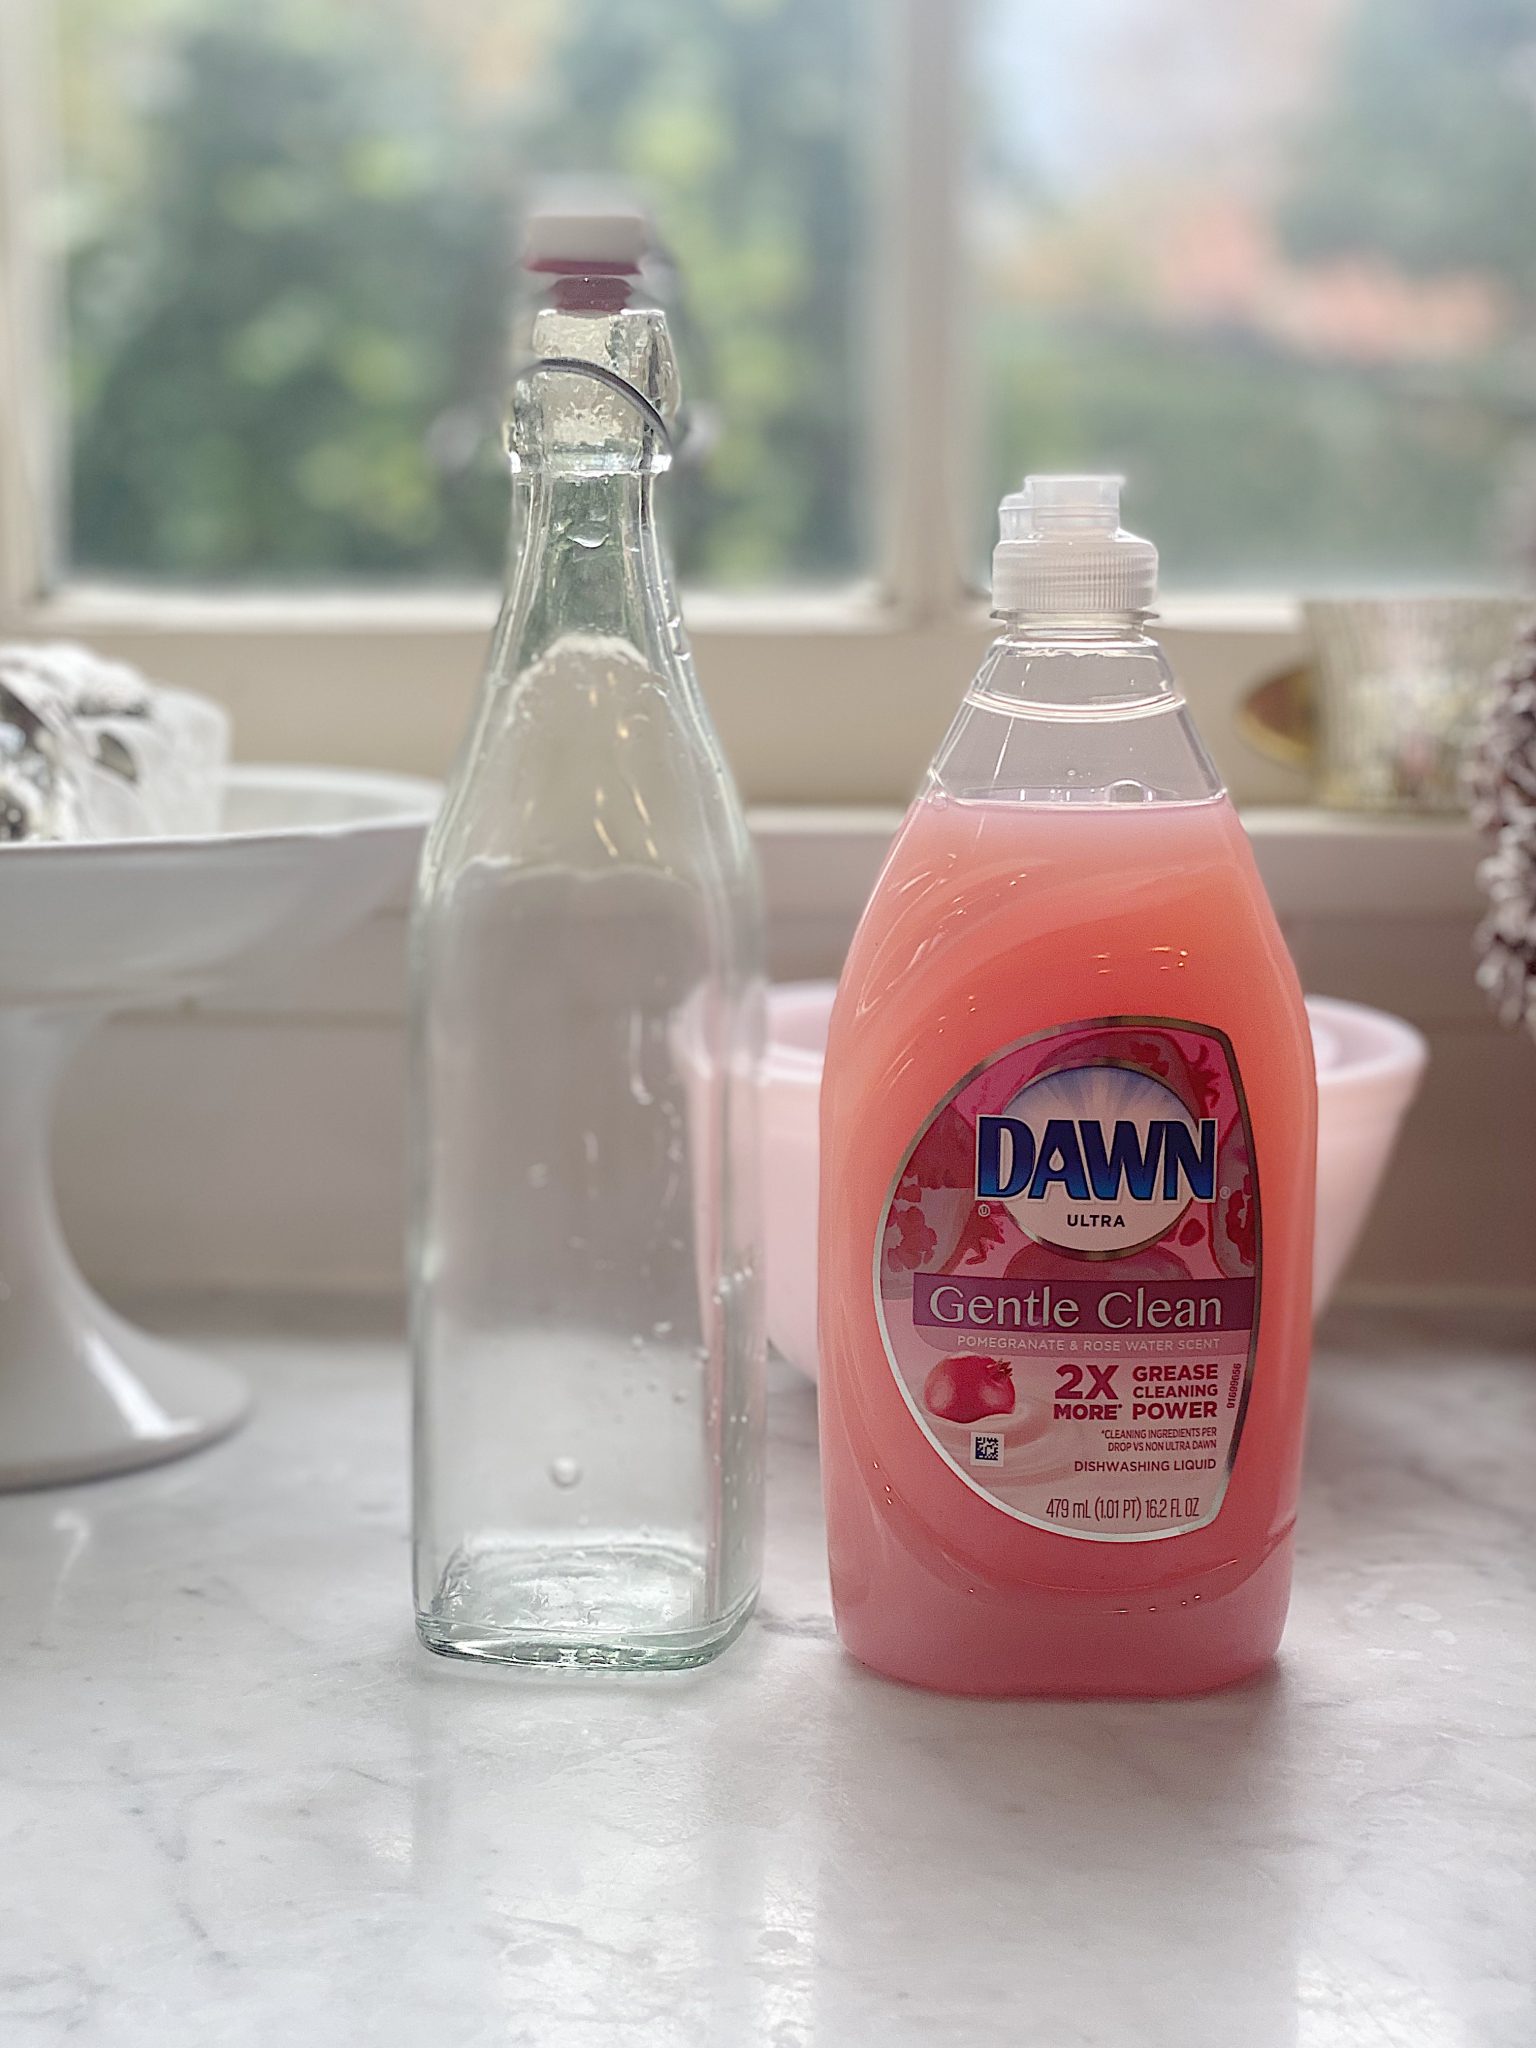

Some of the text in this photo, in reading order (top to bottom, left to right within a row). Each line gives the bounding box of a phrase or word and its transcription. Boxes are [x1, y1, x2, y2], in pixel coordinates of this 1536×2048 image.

[975, 1114, 1218, 1203] DAWN
[1067, 1214, 1125, 1228] ULTRA
[929, 1285, 1222, 1329] Gentle Clean
[957, 1335, 1220, 1352] POMEGRANATE & ROSE WATER SCENT
[1132, 1363, 1219, 1382] GREASE
[1054, 1364, 1120, 1400] 2X
[1132, 1383, 1219, 1399] CLEANING
[1132, 1400, 1218, 1420] POWER
[1148, 1428, 1201, 1439] INGREDIENTS
[1201, 1426, 1217, 1437] PER
[1107, 1439, 1217, 1452] DROP VS NON ULTRA DAWN
[1074, 1458, 1217, 1472] DISHWASHING LIQUID
[1045, 1496, 1200, 1521] 479 mL (1.01 PT) 16.2 FL OZ
